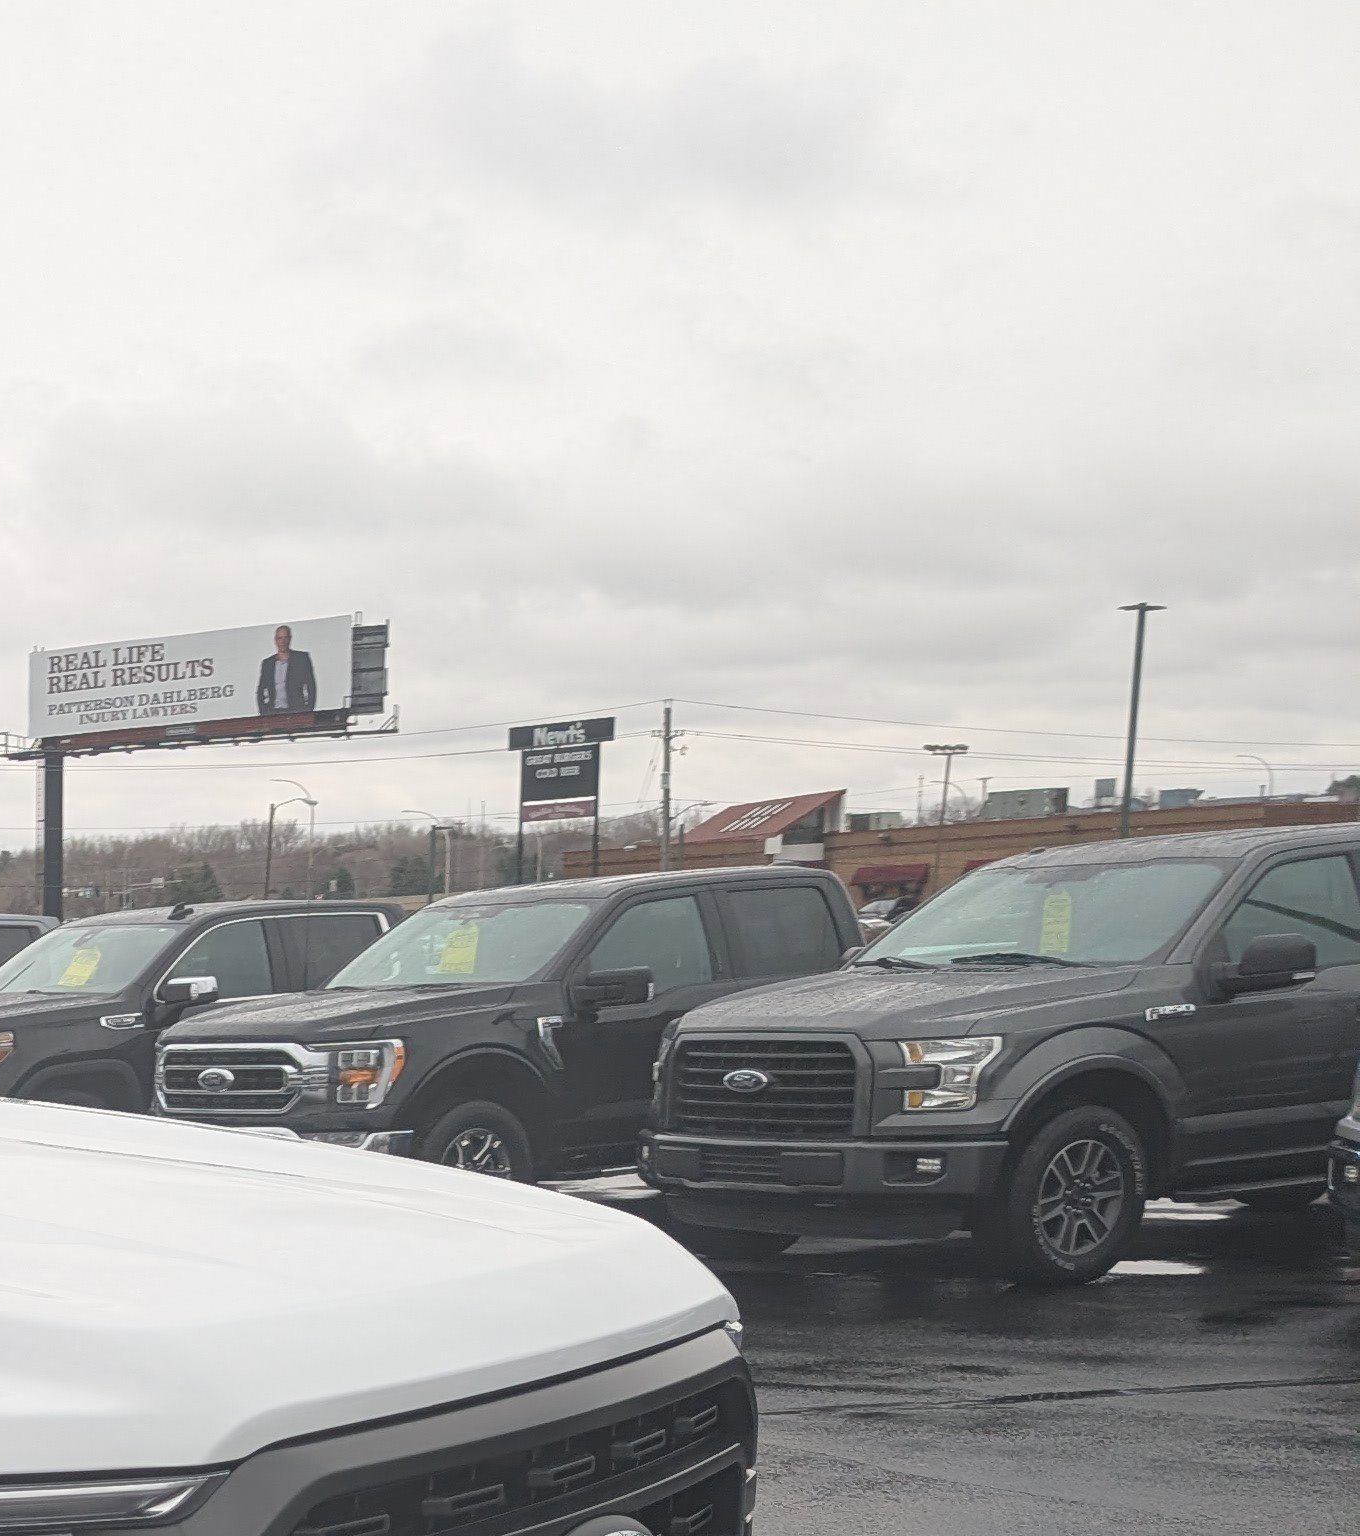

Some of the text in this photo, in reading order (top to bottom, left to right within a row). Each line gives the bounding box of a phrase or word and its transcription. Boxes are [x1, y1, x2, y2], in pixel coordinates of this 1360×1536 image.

[48, 643, 165, 674] REAL LIFE
[47, 658, 214, 694] REAL RESULTS
[47, 684, 235, 716] PATTERSON DAHLBERG
[79, 702, 198, 725] INJURY LAWYERS
[533, 722, 586, 746] Newt's
